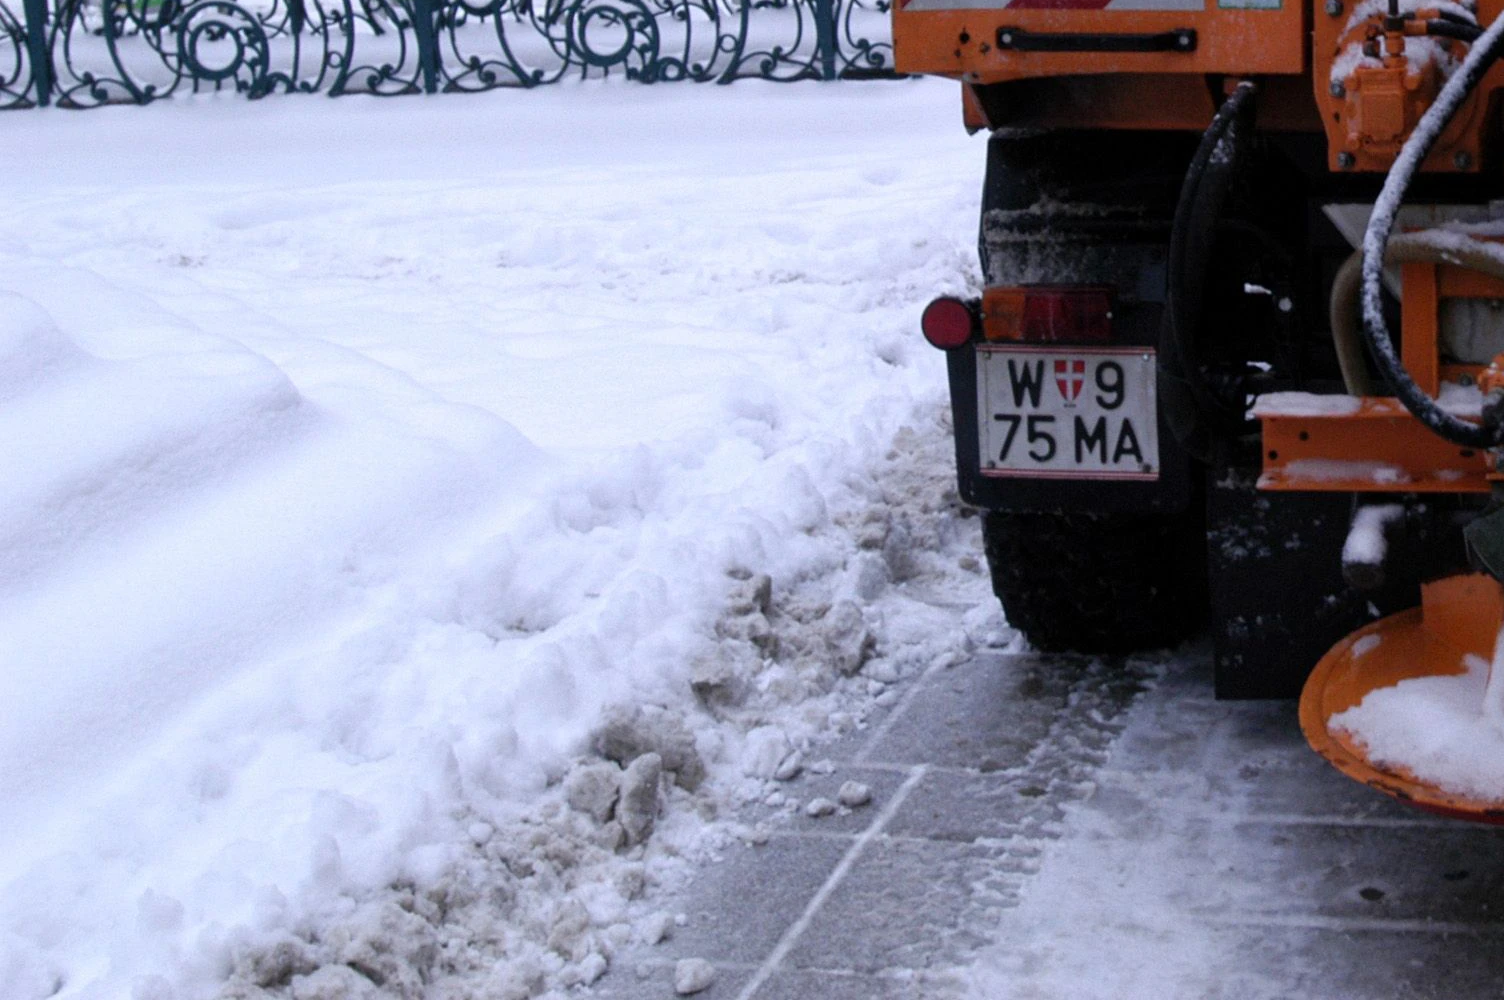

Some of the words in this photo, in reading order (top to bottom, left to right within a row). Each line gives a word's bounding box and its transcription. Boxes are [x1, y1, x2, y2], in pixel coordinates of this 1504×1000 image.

[1008, 359, 1044, 408] W
[1095, 360, 1124, 410] 9
[994, 413, 1056, 463] 75
[1074, 415, 1143, 464] MA
